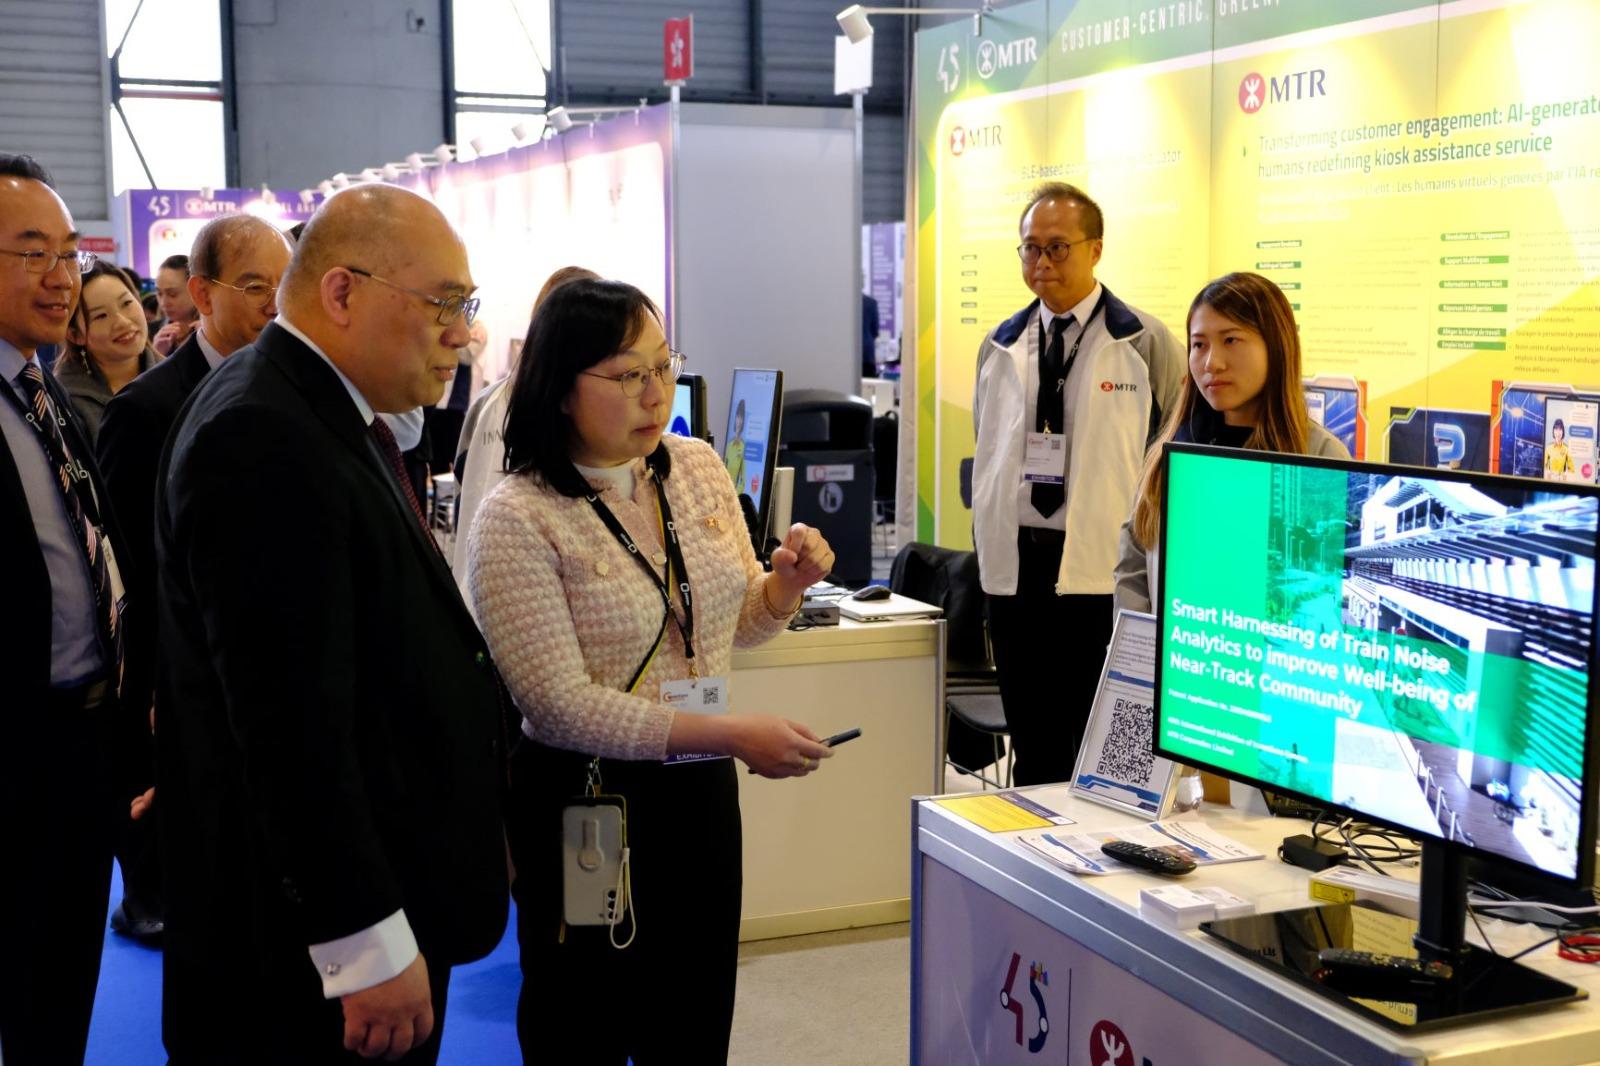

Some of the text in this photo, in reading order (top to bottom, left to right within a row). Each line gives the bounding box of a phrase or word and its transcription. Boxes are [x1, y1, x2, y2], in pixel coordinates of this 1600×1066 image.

[997, 38, 1037, 69] MTR
[1270, 69, 1327, 104] MTR
[1258, 130, 1338, 152] Transforming
[1341, 121, 1403, 142] customer
[1406, 108, 1503, 138] engagement:
[1258, 132, 1553, 178] humans redefining kiosk assistance service
[1414, 177, 1457, 192] humains
[1458, 173, 1498, 188] virtuels
[202, 201, 237, 213] MTR
[1114, 383, 1137, 392] MTR
[1171, 598, 1451, 674] Smart Harnessing of Train Noise
[1170, 625, 1242, 658] Analytics
[1245, 640, 1263, 662] to
[1267, 645, 1338, 680] Improve
[1343, 663, 1449, 711] Well-being
[1454, 689, 1477, 713] of
[1170, 652, 1255, 689] Near-Track
[1259, 678, 1364, 720] Community
